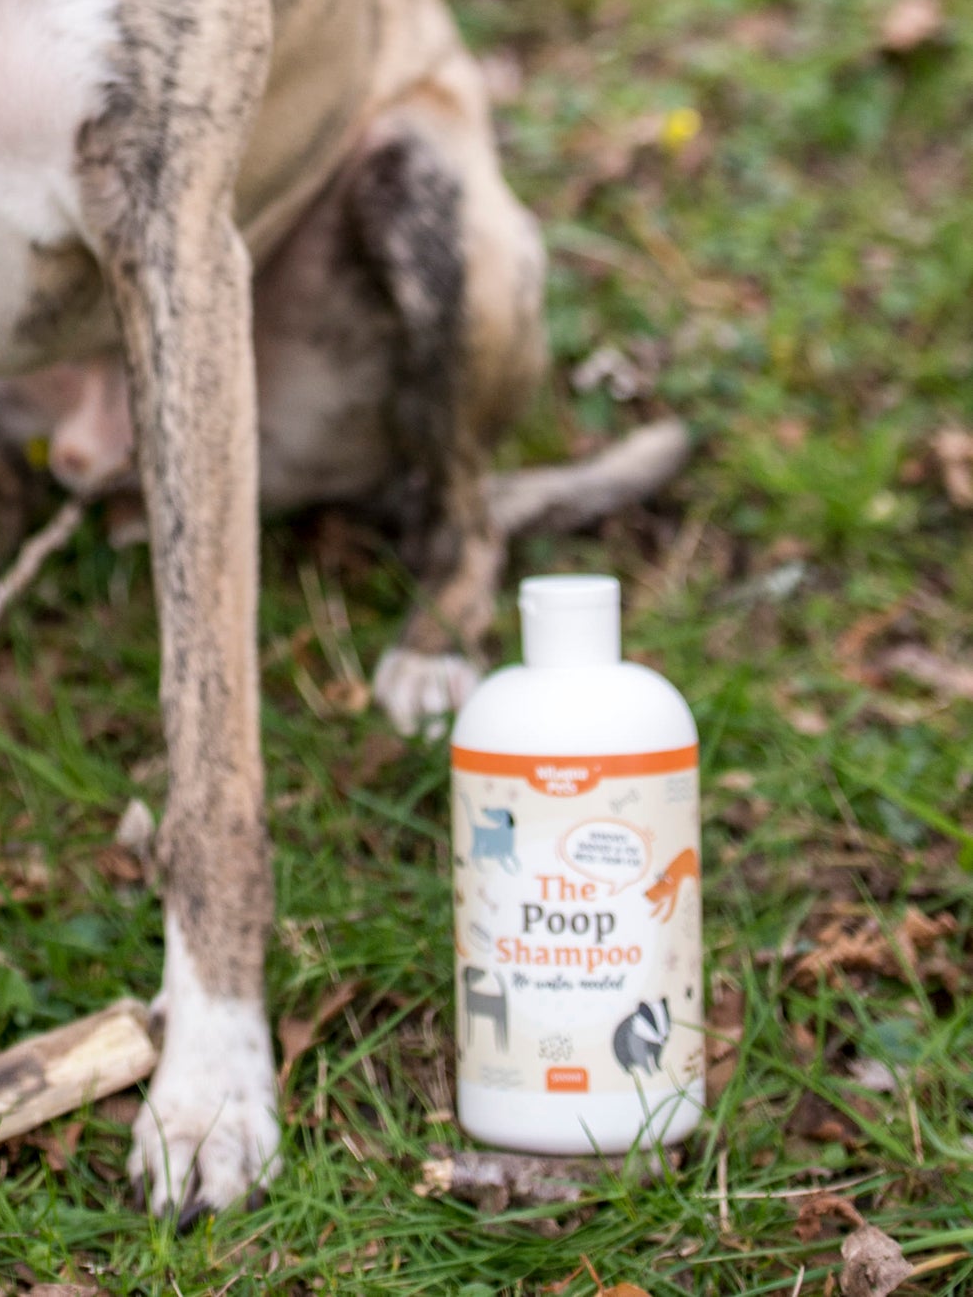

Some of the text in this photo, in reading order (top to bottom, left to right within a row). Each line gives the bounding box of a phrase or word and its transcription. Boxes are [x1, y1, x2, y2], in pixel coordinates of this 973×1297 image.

[535, 874, 596, 901] The
[522, 902, 615, 944] Poop
[496, 936, 643, 974] Shampoo
